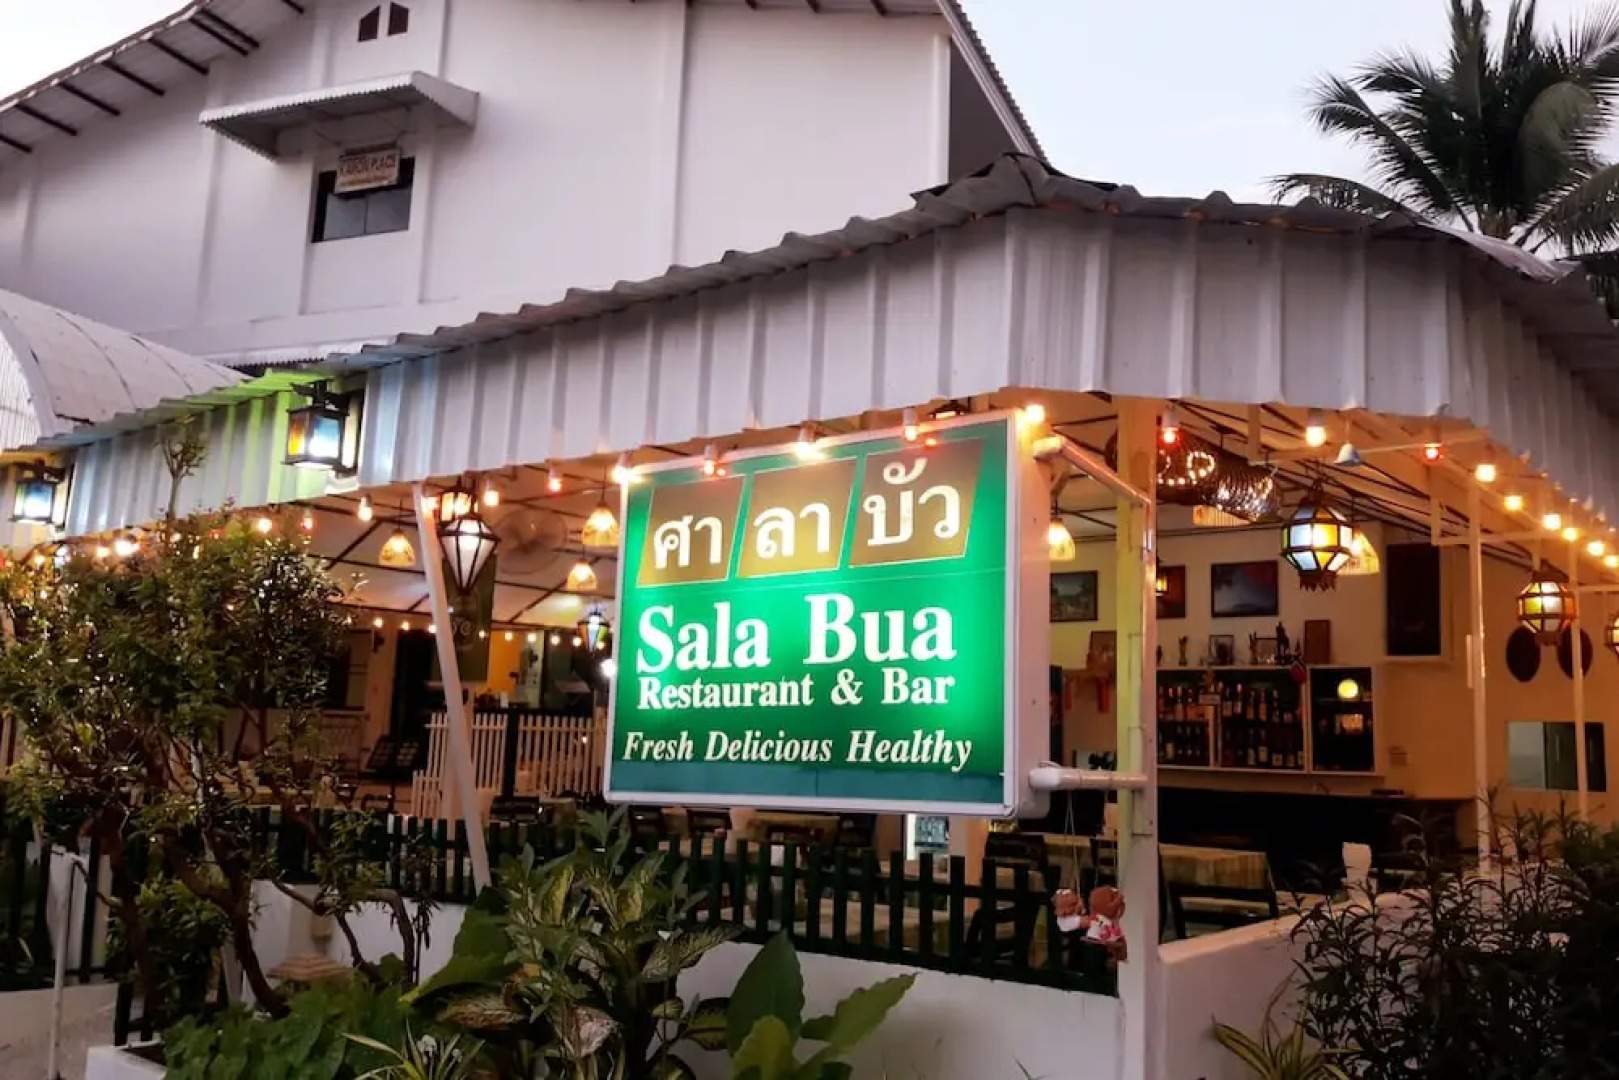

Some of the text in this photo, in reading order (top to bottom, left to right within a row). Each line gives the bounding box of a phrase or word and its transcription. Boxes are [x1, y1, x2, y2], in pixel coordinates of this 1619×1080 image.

[636, 593, 957, 673] Sala Bua
[637, 667, 956, 710] Restaurant & Bar
[622, 728, 972, 773] Fresh Delicious Healthy
